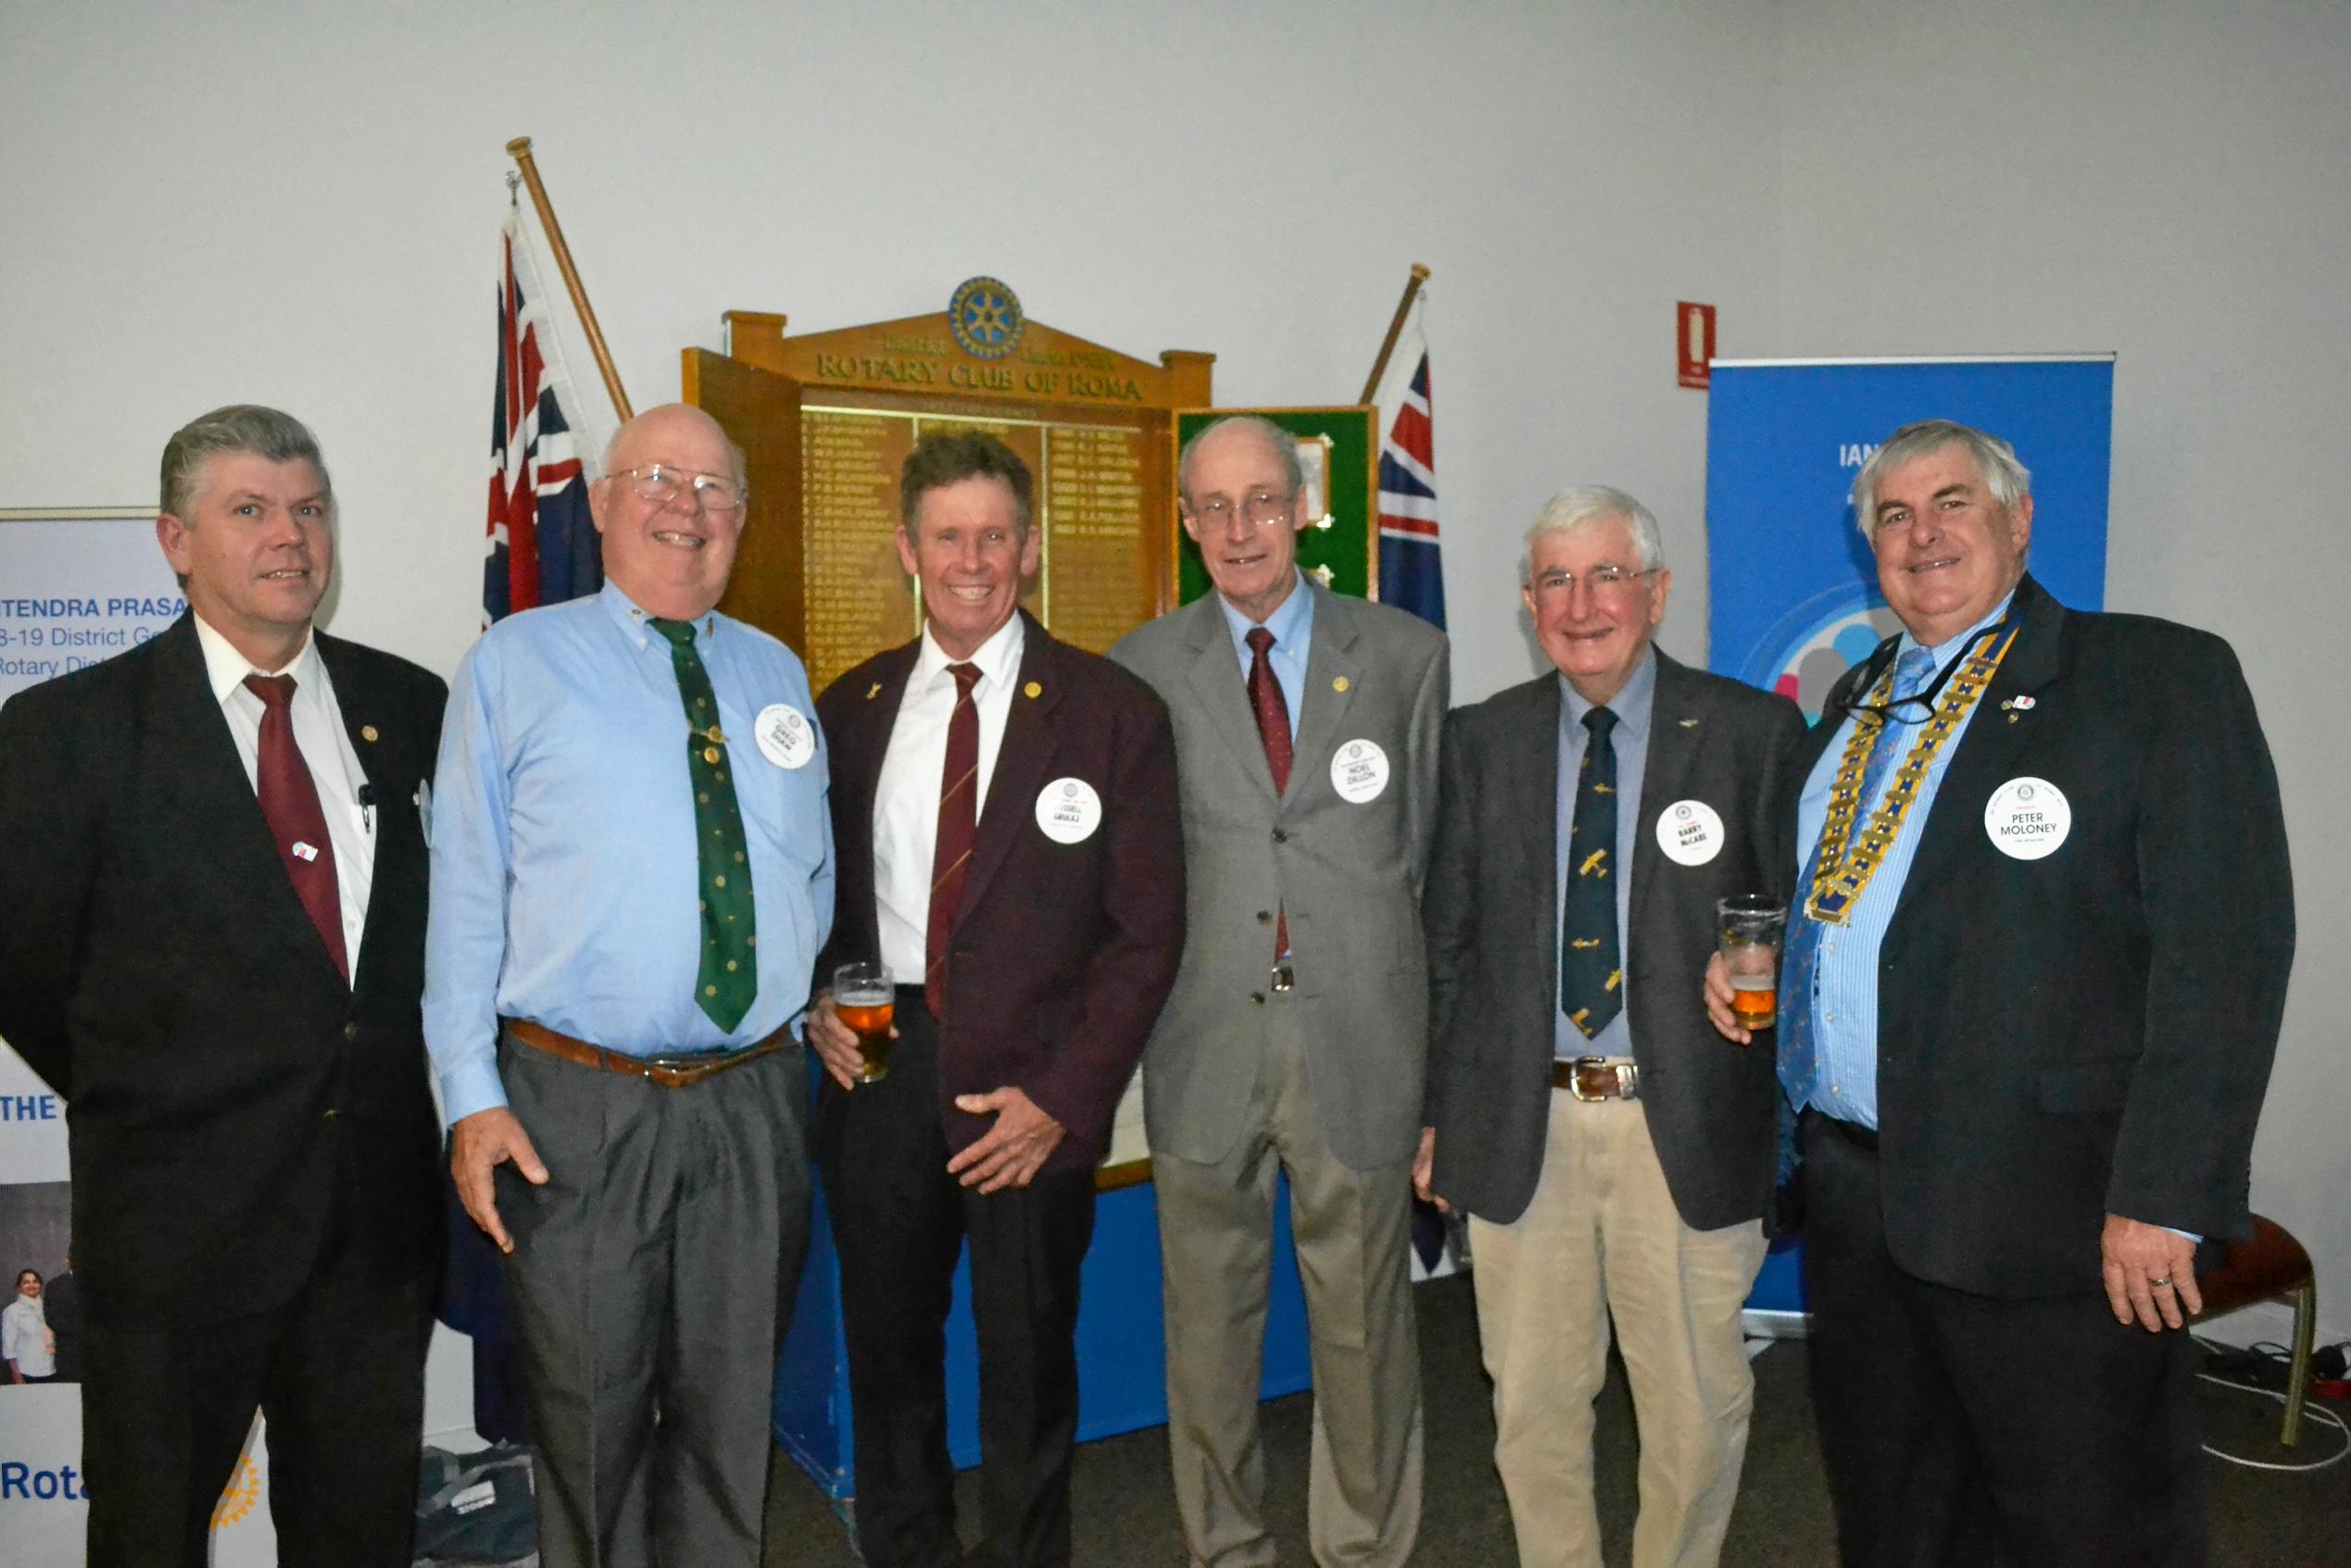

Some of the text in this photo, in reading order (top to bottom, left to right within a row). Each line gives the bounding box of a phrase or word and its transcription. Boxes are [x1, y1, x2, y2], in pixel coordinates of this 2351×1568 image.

[816, 353, 938, 384] ROTARY
[948, 364, 1014, 390] CLUB
[1024, 370, 1059, 394] OF
[1, 597, 186, 618] TENDRA PRASA
[51, 626, 126, 646] District
[2012, 812, 2043, 823] PETER
[2000, 822, 2057, 835] MOLONEY
[0, 1095, 57, 1122] THE
[1, 1461, 90, 1500] Rot
